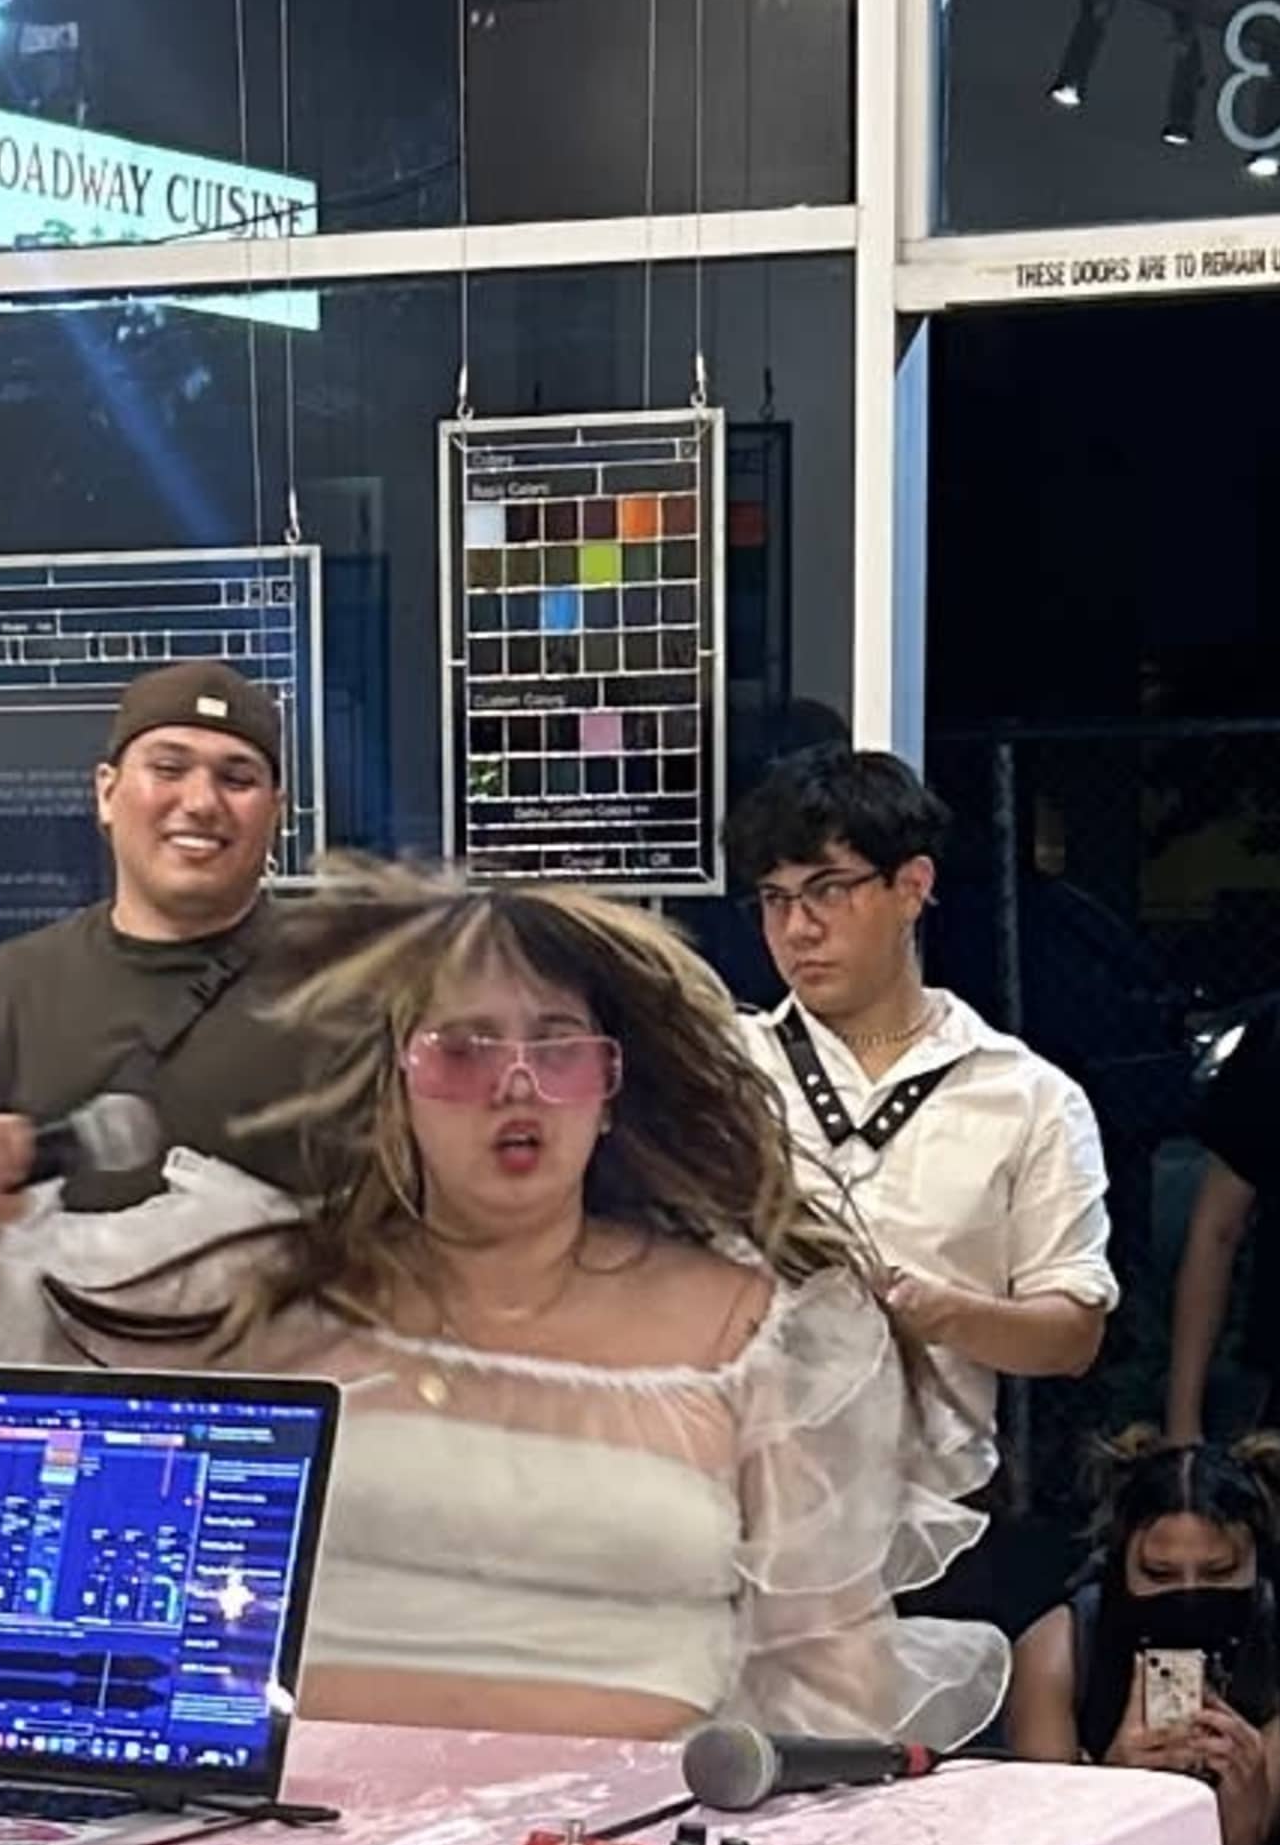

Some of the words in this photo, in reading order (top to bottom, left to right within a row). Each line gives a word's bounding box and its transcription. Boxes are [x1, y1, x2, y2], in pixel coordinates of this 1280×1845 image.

[166, 174, 303, 237] CUISINE
[1017, 261, 1065, 287] THESE
[1072, 257, 1130, 285] DOORS
[1137, 254, 1166, 281] ARE
[1175, 251, 1196, 278] TO
[1202, 247, 1266, 276] REMAIN
